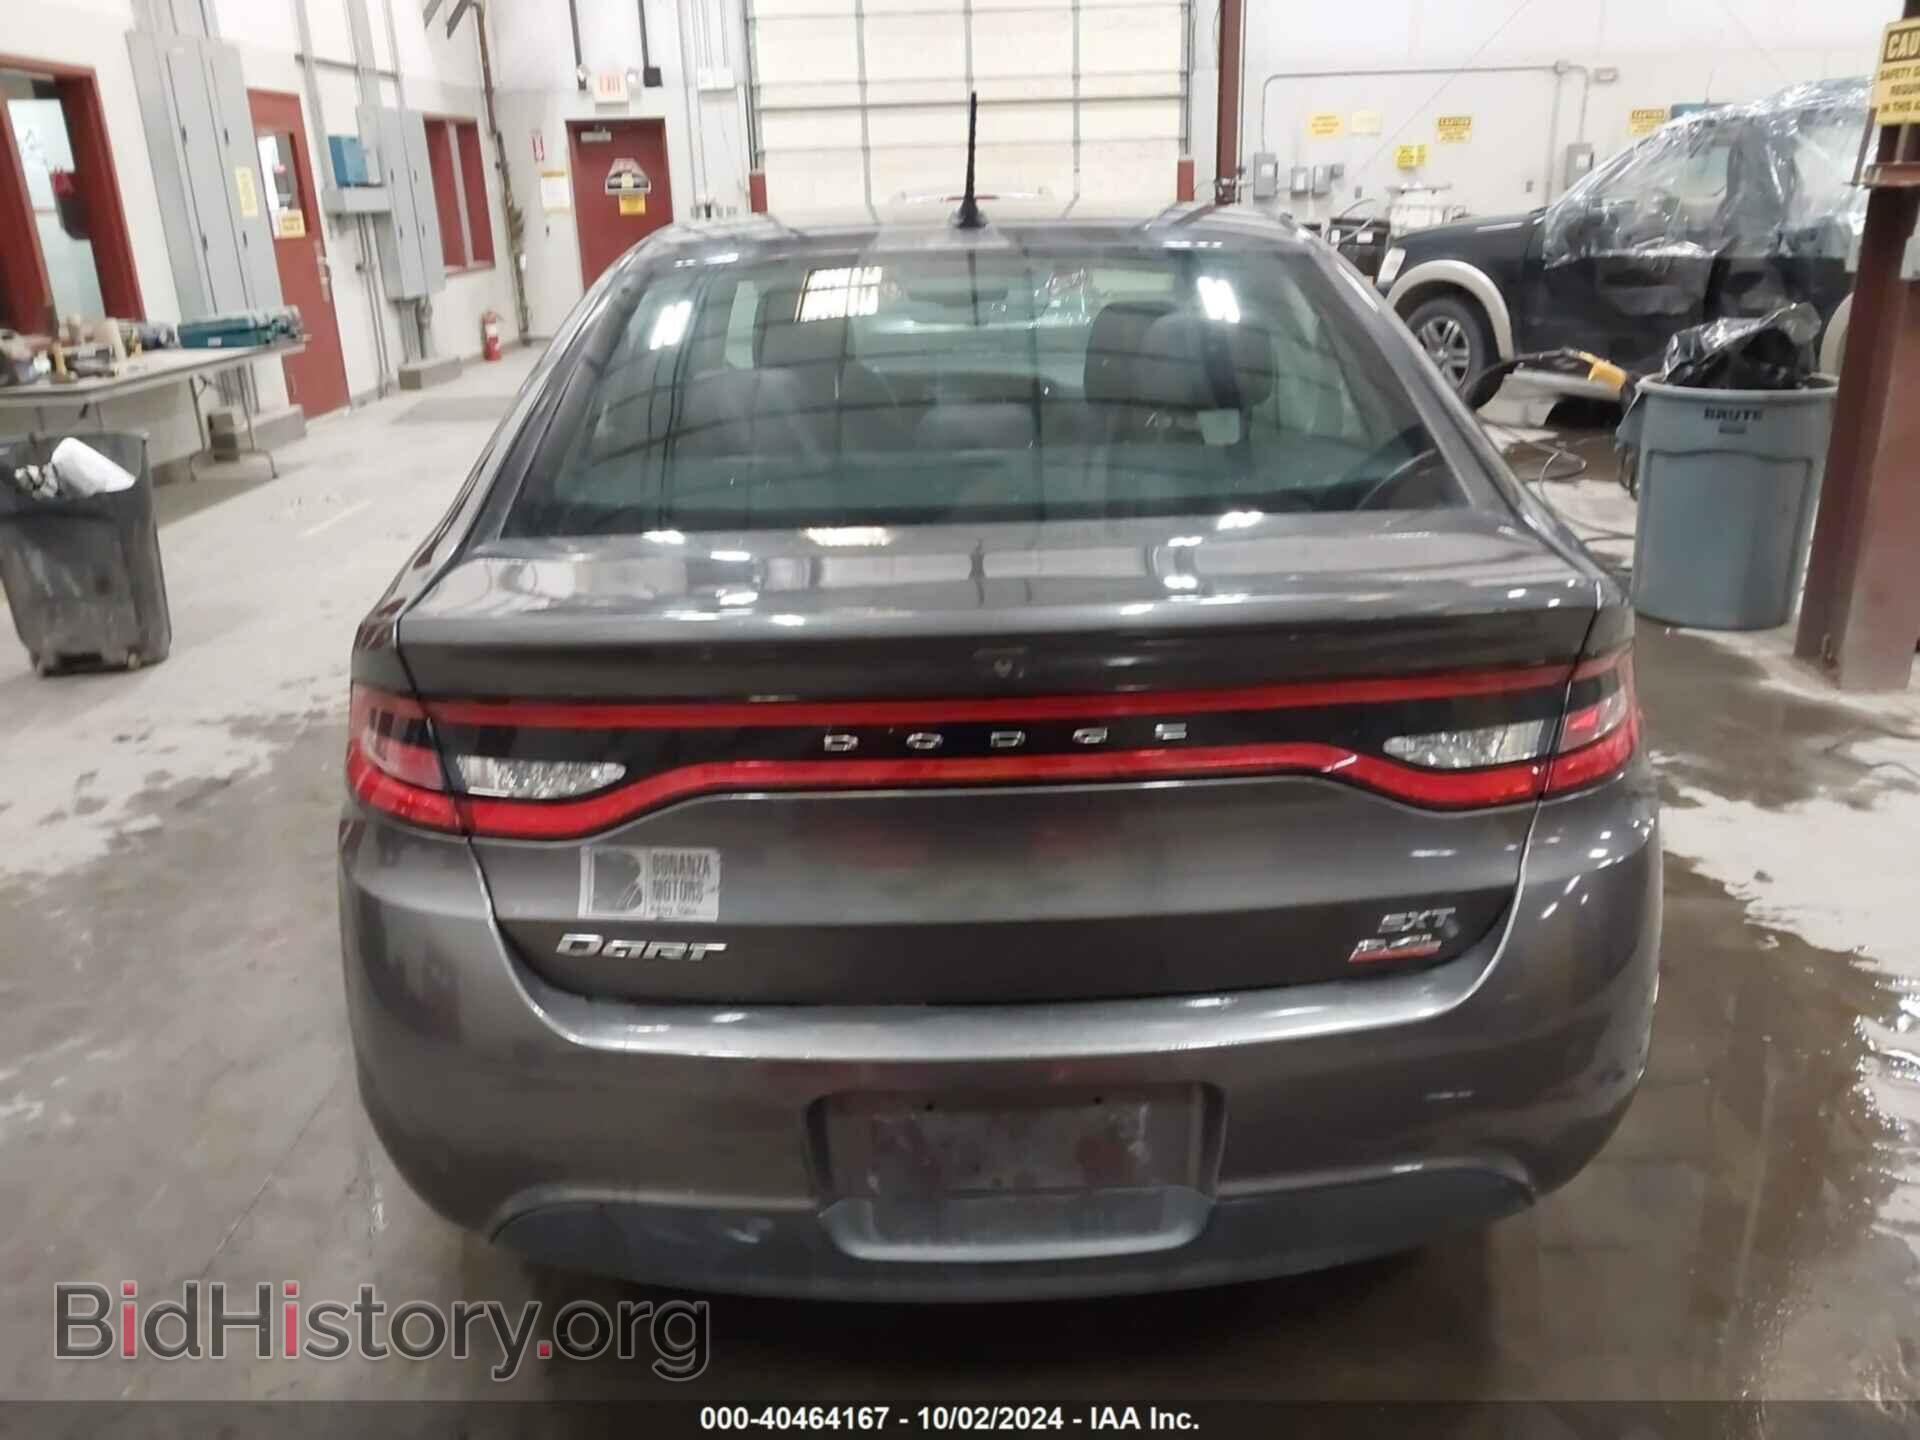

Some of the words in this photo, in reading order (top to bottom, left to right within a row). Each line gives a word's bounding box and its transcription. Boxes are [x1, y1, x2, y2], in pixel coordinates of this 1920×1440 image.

[1703, 407, 1762, 421] BRUTE
[824, 722, 1188, 752] DODGE
[652, 853, 711, 878] BONANZA
[652, 880, 705, 904] MOTORS
[1377, 907, 1456, 934] SXT
